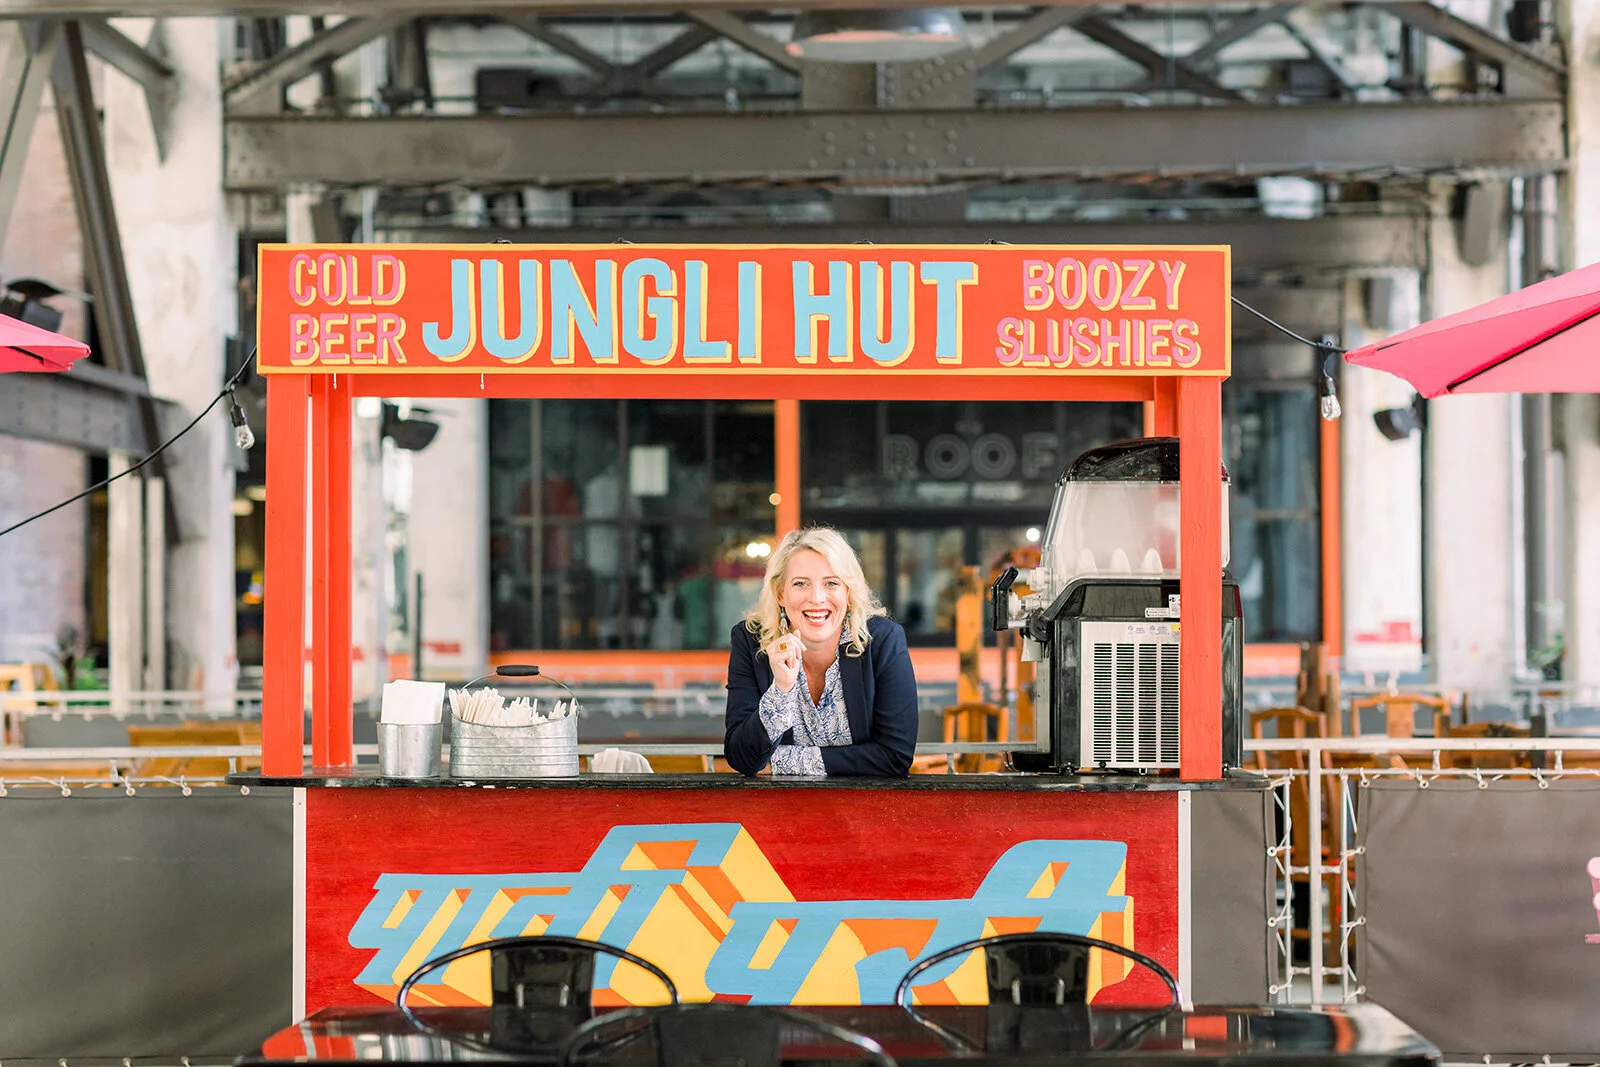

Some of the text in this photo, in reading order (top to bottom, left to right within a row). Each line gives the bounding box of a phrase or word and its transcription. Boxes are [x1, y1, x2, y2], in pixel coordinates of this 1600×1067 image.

[289, 253, 406, 306] COLD
[1022, 257, 1186, 310] BOOZY
[422, 258, 978, 365] JUNGLI HUT
[289, 312, 407, 365] BEER
[995, 317, 1201, 368] SLUSHIES
[882, 432, 1059, 480] ROOF
